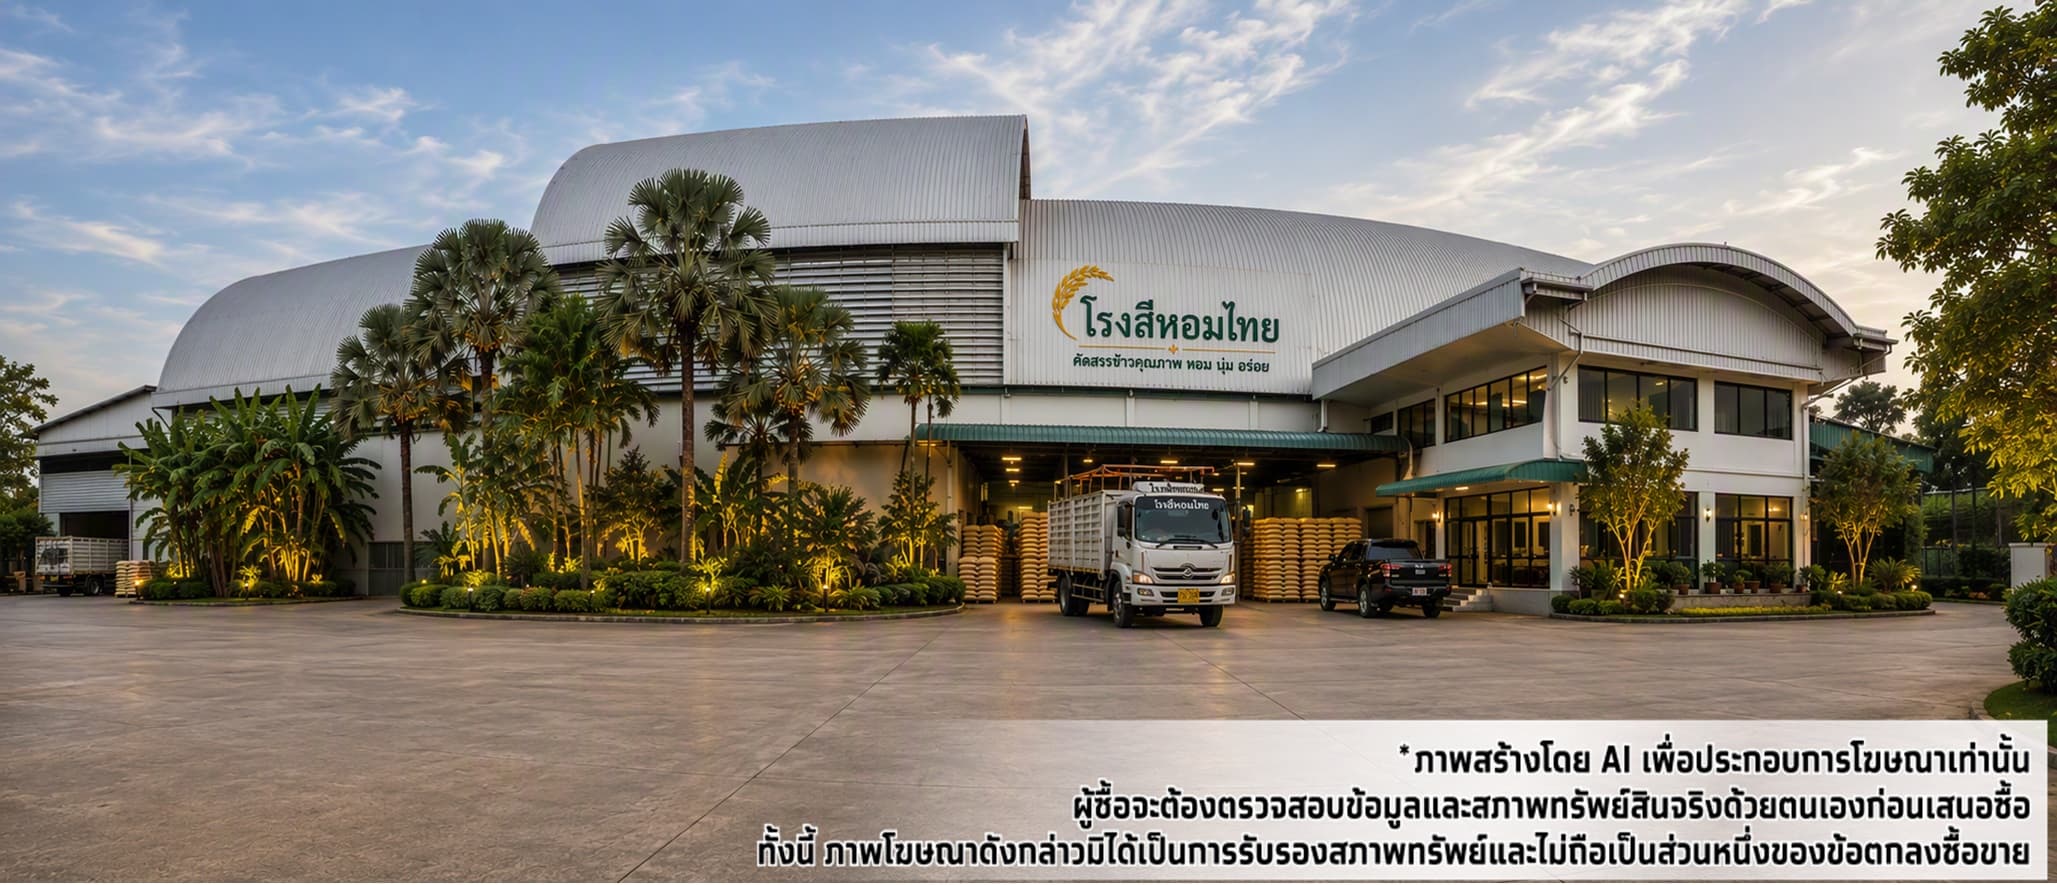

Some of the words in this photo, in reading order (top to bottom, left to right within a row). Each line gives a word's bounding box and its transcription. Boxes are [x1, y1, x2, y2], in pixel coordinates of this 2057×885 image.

[1080, 295, 1280, 343] โรงสีหอมไทย
[1073, 353, 1183, 373] คัดสรรข้าวคุณภาพ
[1217, 357, 1234, 375] นุ่ม
[1238, 358, 1270, 373] อร่อย
